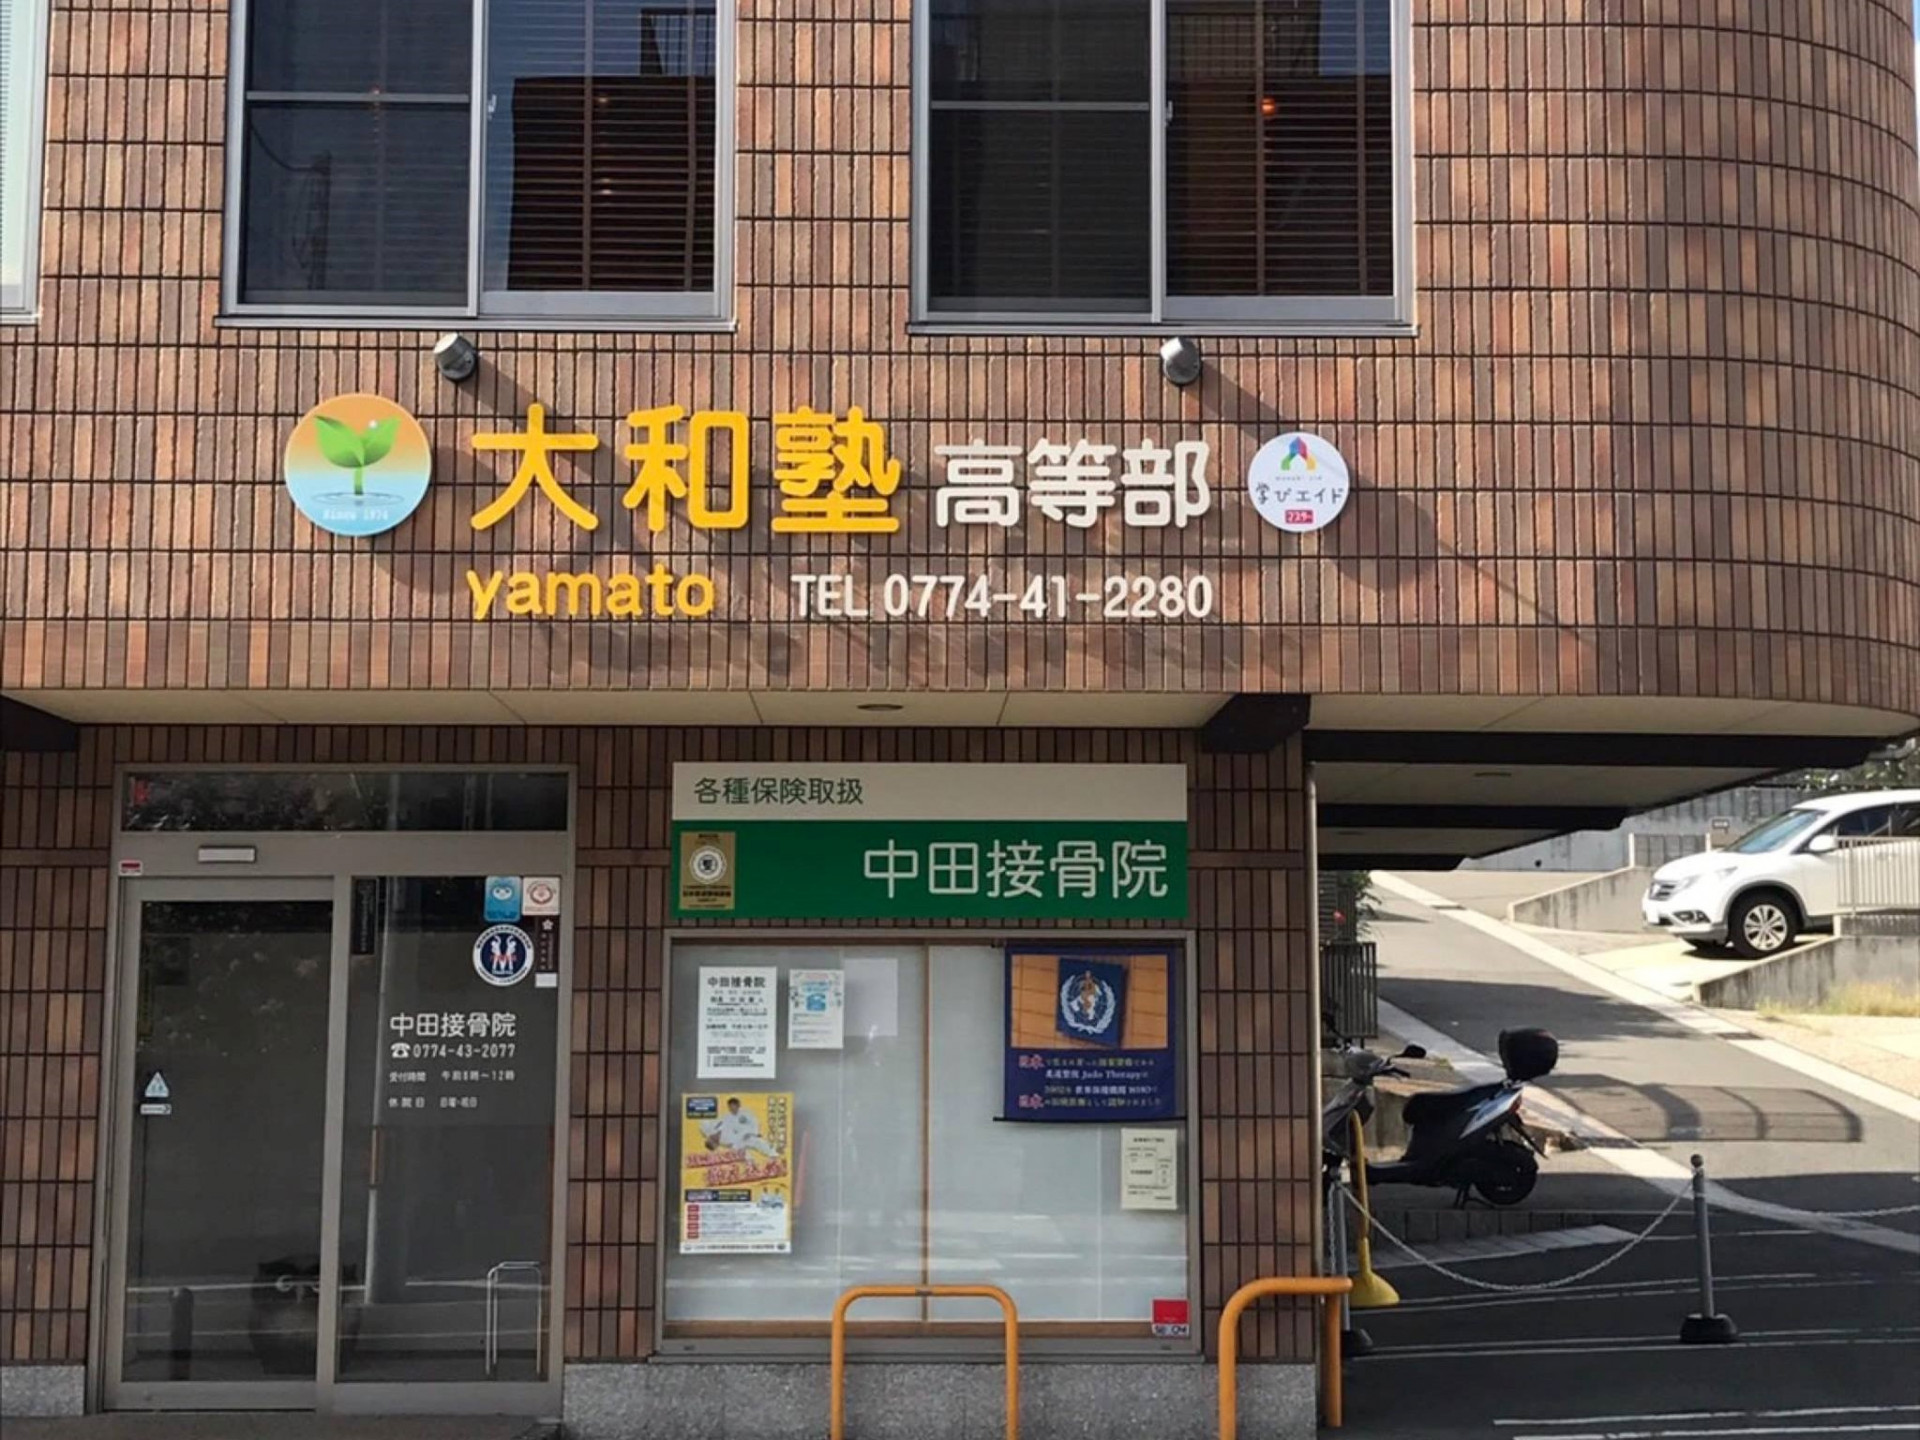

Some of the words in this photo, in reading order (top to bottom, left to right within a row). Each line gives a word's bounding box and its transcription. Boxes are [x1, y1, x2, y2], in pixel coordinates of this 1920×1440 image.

[471, 402, 900, 534] 大和塾
[934, 438, 1212, 529] 高等部
[1256, 481, 1344, 505] 学びエイド
[466, 563, 715, 620] yamato
[790, 575, 868, 618] TEL
[883, 574, 1213, 619] 0774-41-2280
[694, 777, 863, 804] 各種保険取扱
[864, 839, 1169, 900] 中田接骨院
[390, 1012, 516, 1037] 中田接骨院
[413, 1043, 516, 1058] 0774-43-2077
